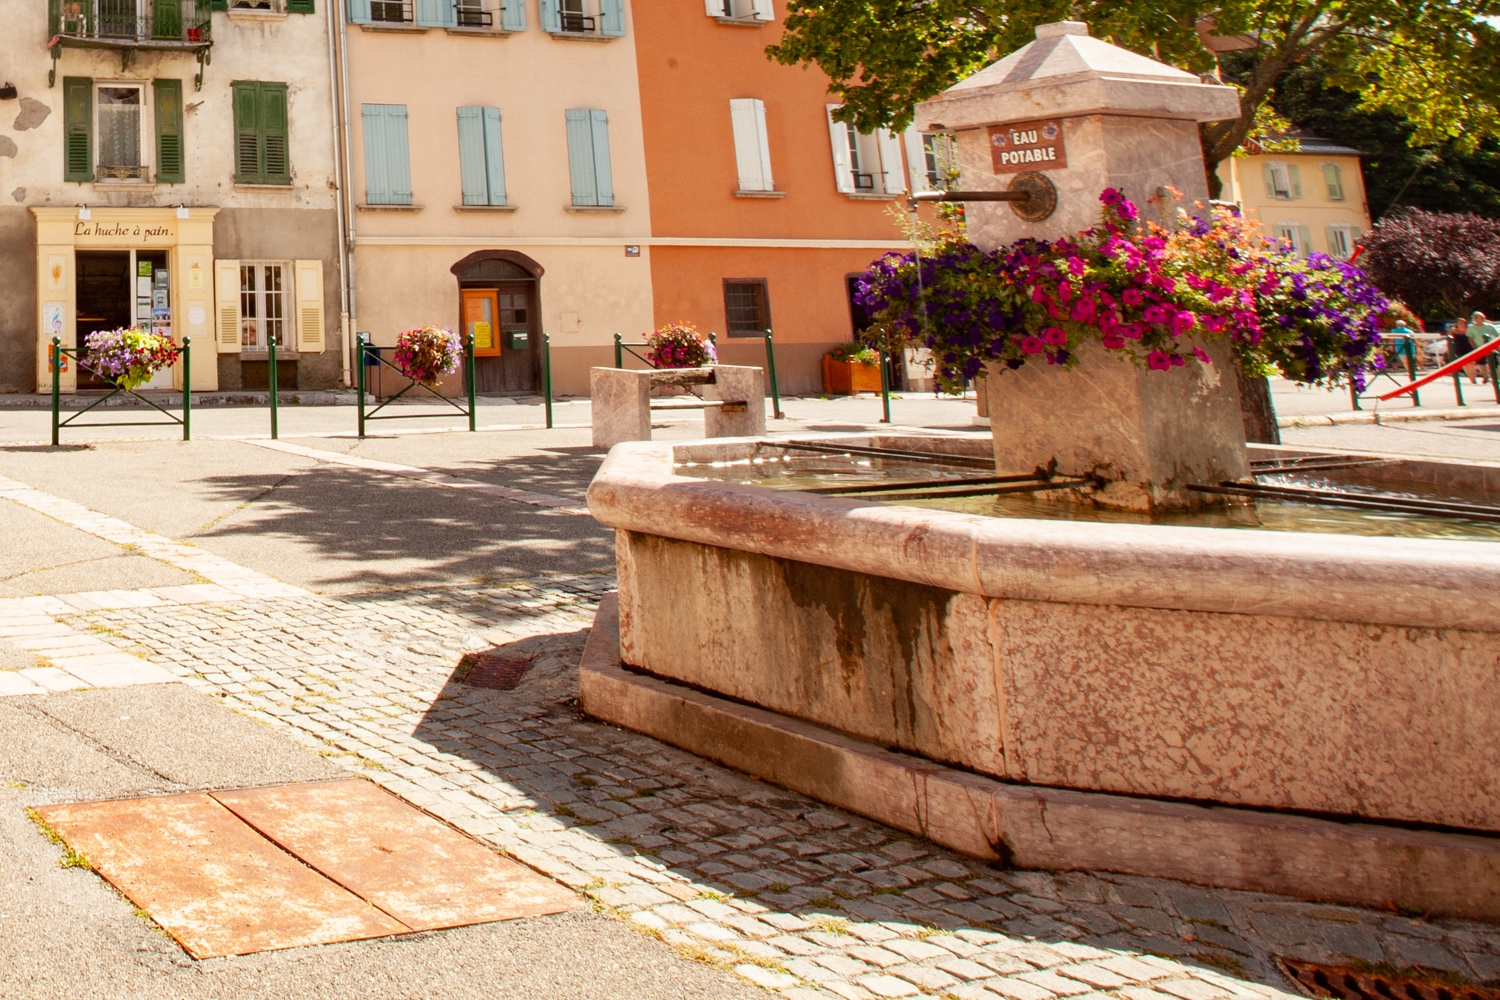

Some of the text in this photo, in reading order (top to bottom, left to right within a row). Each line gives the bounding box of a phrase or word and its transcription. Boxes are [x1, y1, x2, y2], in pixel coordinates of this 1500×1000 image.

[1012, 130, 1038, 145] EAU
[1001, 147, 1056, 165] POTABLE
[74, 221, 91, 236] La
[94, 222, 130, 236] huche
[133, 226, 140, 236] à
